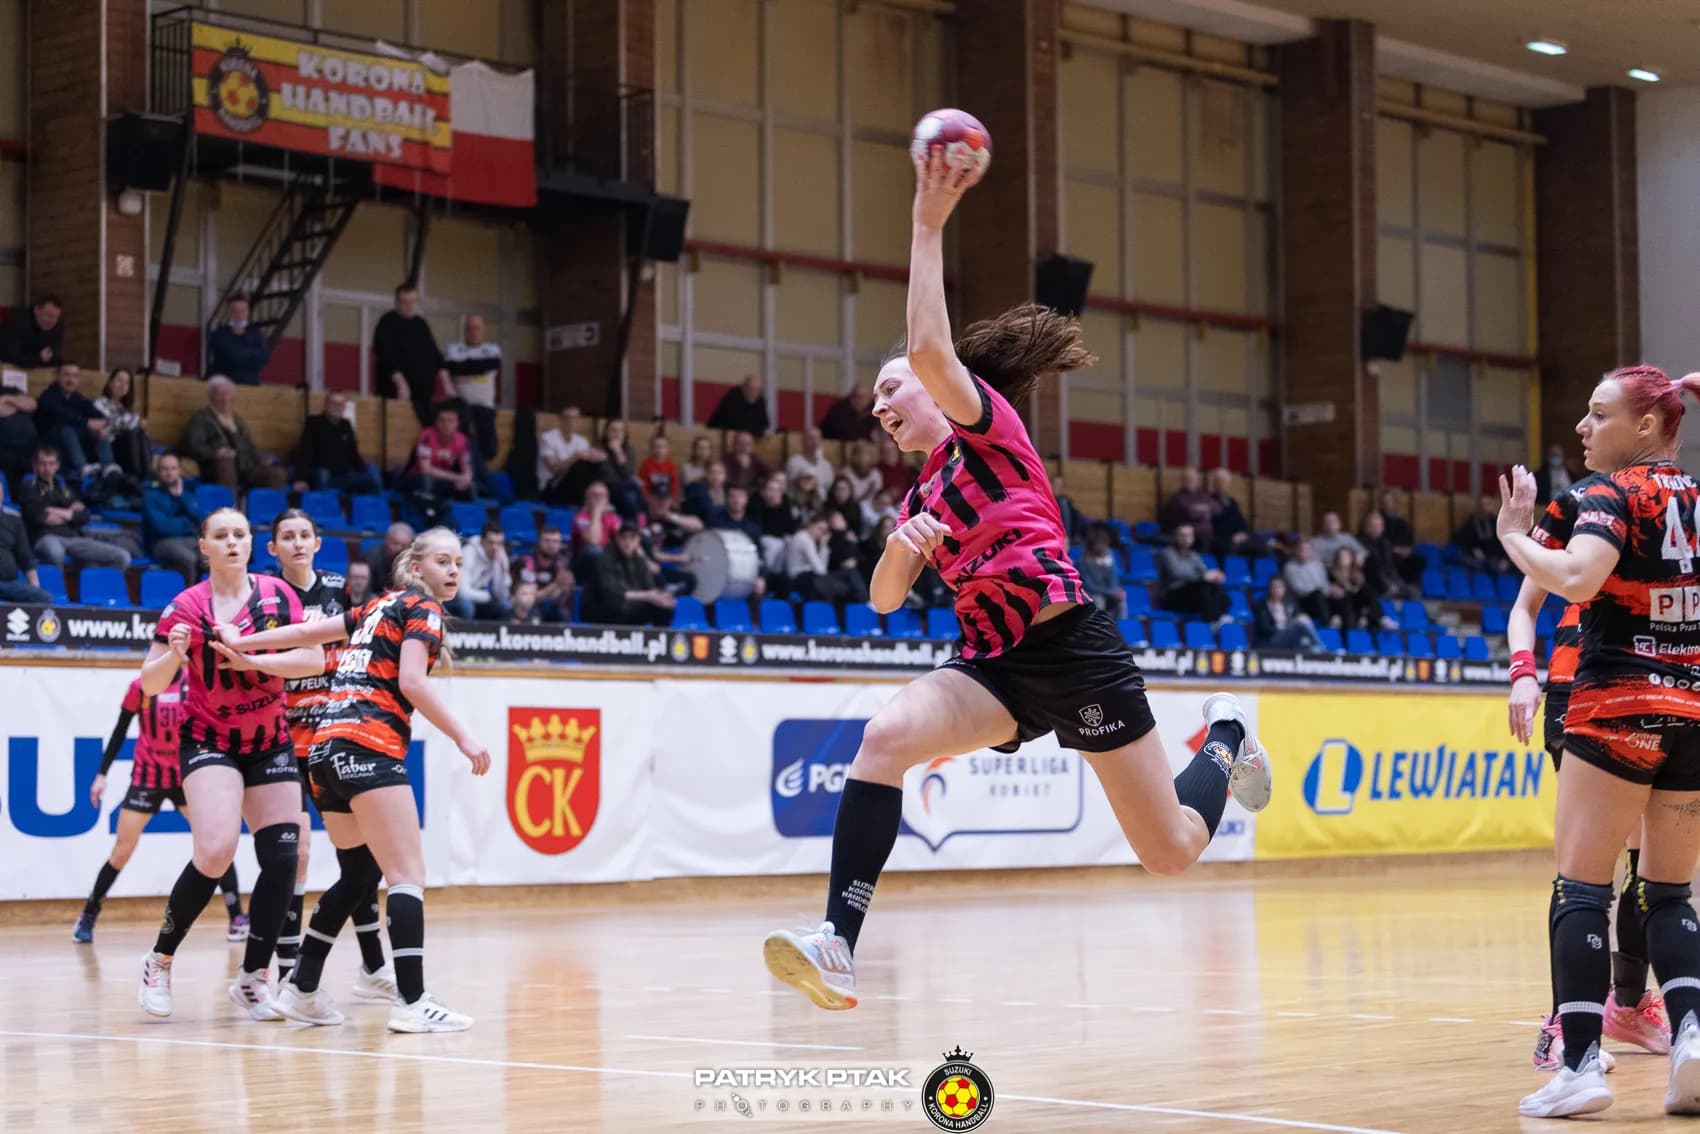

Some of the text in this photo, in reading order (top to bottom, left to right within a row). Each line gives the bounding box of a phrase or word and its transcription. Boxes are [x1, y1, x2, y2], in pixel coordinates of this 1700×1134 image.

[298, 52, 426, 96] KORONA
[329, 125, 403, 159] FANS
[1661, 496, 1700, 560] 4
[445, 626, 667, 662] www.koronahandball.pl
[160, 706, 177, 728] 31
[1079, 719, 1126, 737] PROFIKA
[330, 752, 376, 780] Faber
[969, 757, 1069, 775] SUPERLIGA
[1369, 744, 1544, 800] LEWIATAN
[514, 765, 584, 838] CK
